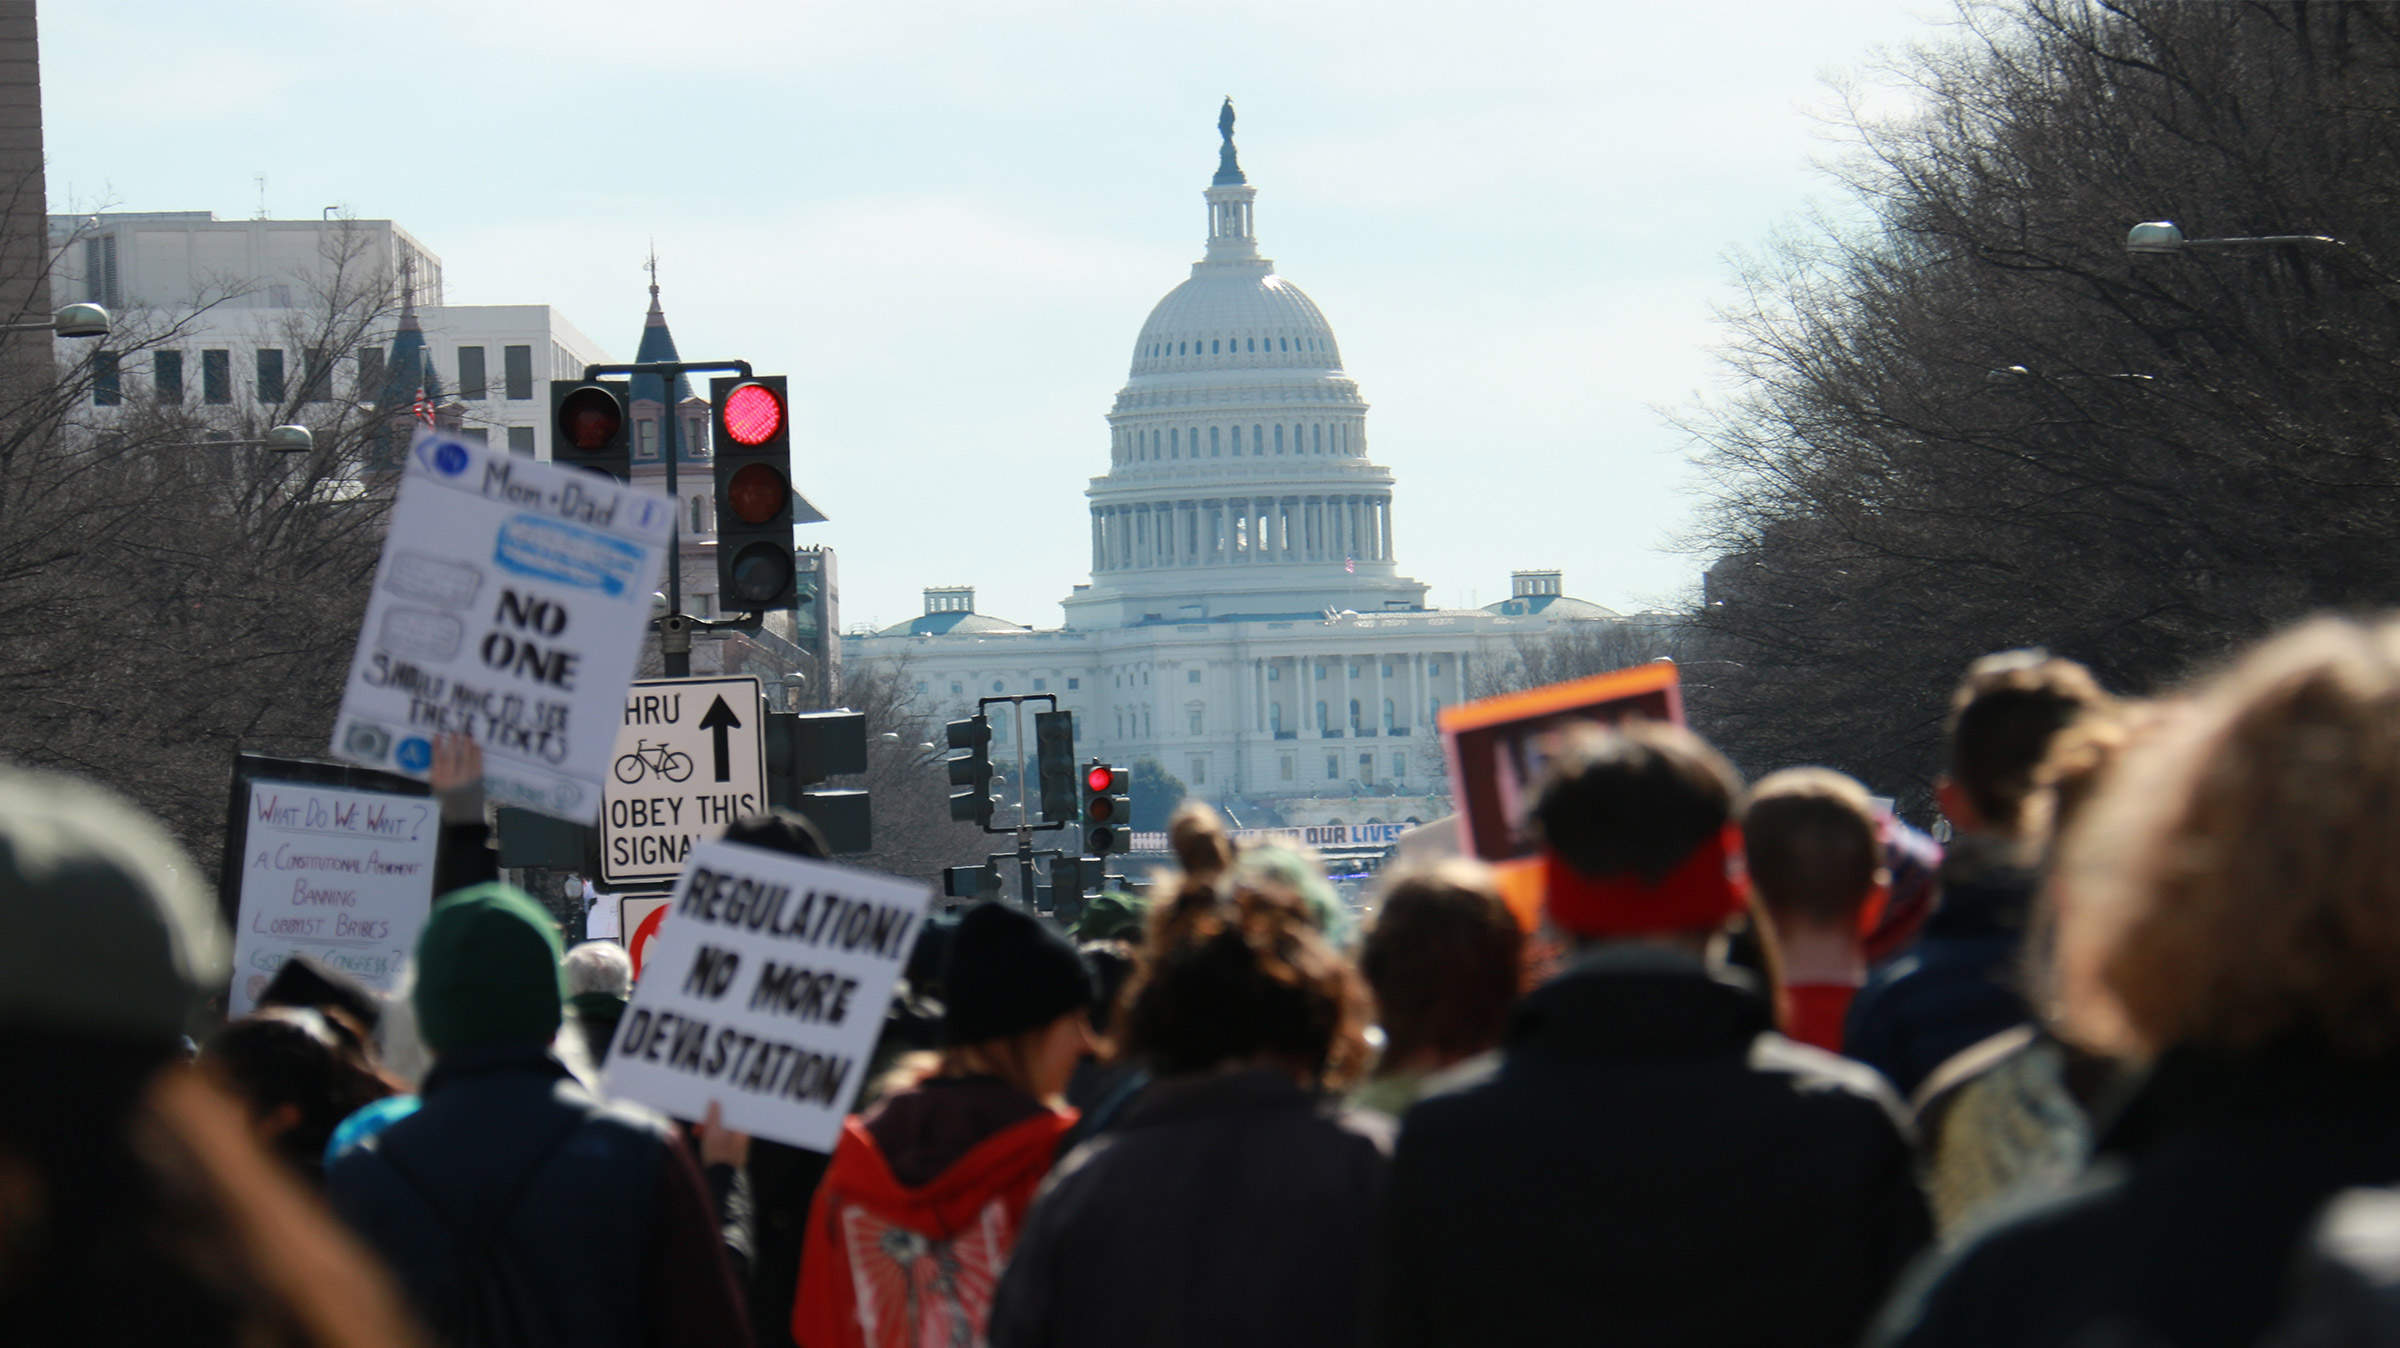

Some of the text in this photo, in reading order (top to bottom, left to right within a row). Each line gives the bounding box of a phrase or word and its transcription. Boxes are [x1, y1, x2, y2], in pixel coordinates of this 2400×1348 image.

[483, 459, 541, 501] Mom
[495, 587, 568, 640] NO
[480, 630, 580, 695] ONE
[624, 693, 680, 726] HRU
[486, 717, 568, 765] TEXTS
[611, 793, 756, 829] OBEY THIS
[613, 834, 692, 867] SIGNA
[1306, 826, 1347, 844] OUR
[252, 851, 270, 870] A
[679, 866, 916, 960] REGULATION!
[683, 944, 859, 1028] NO MORE
[621, 1007, 854, 1110] DEVASTATION
